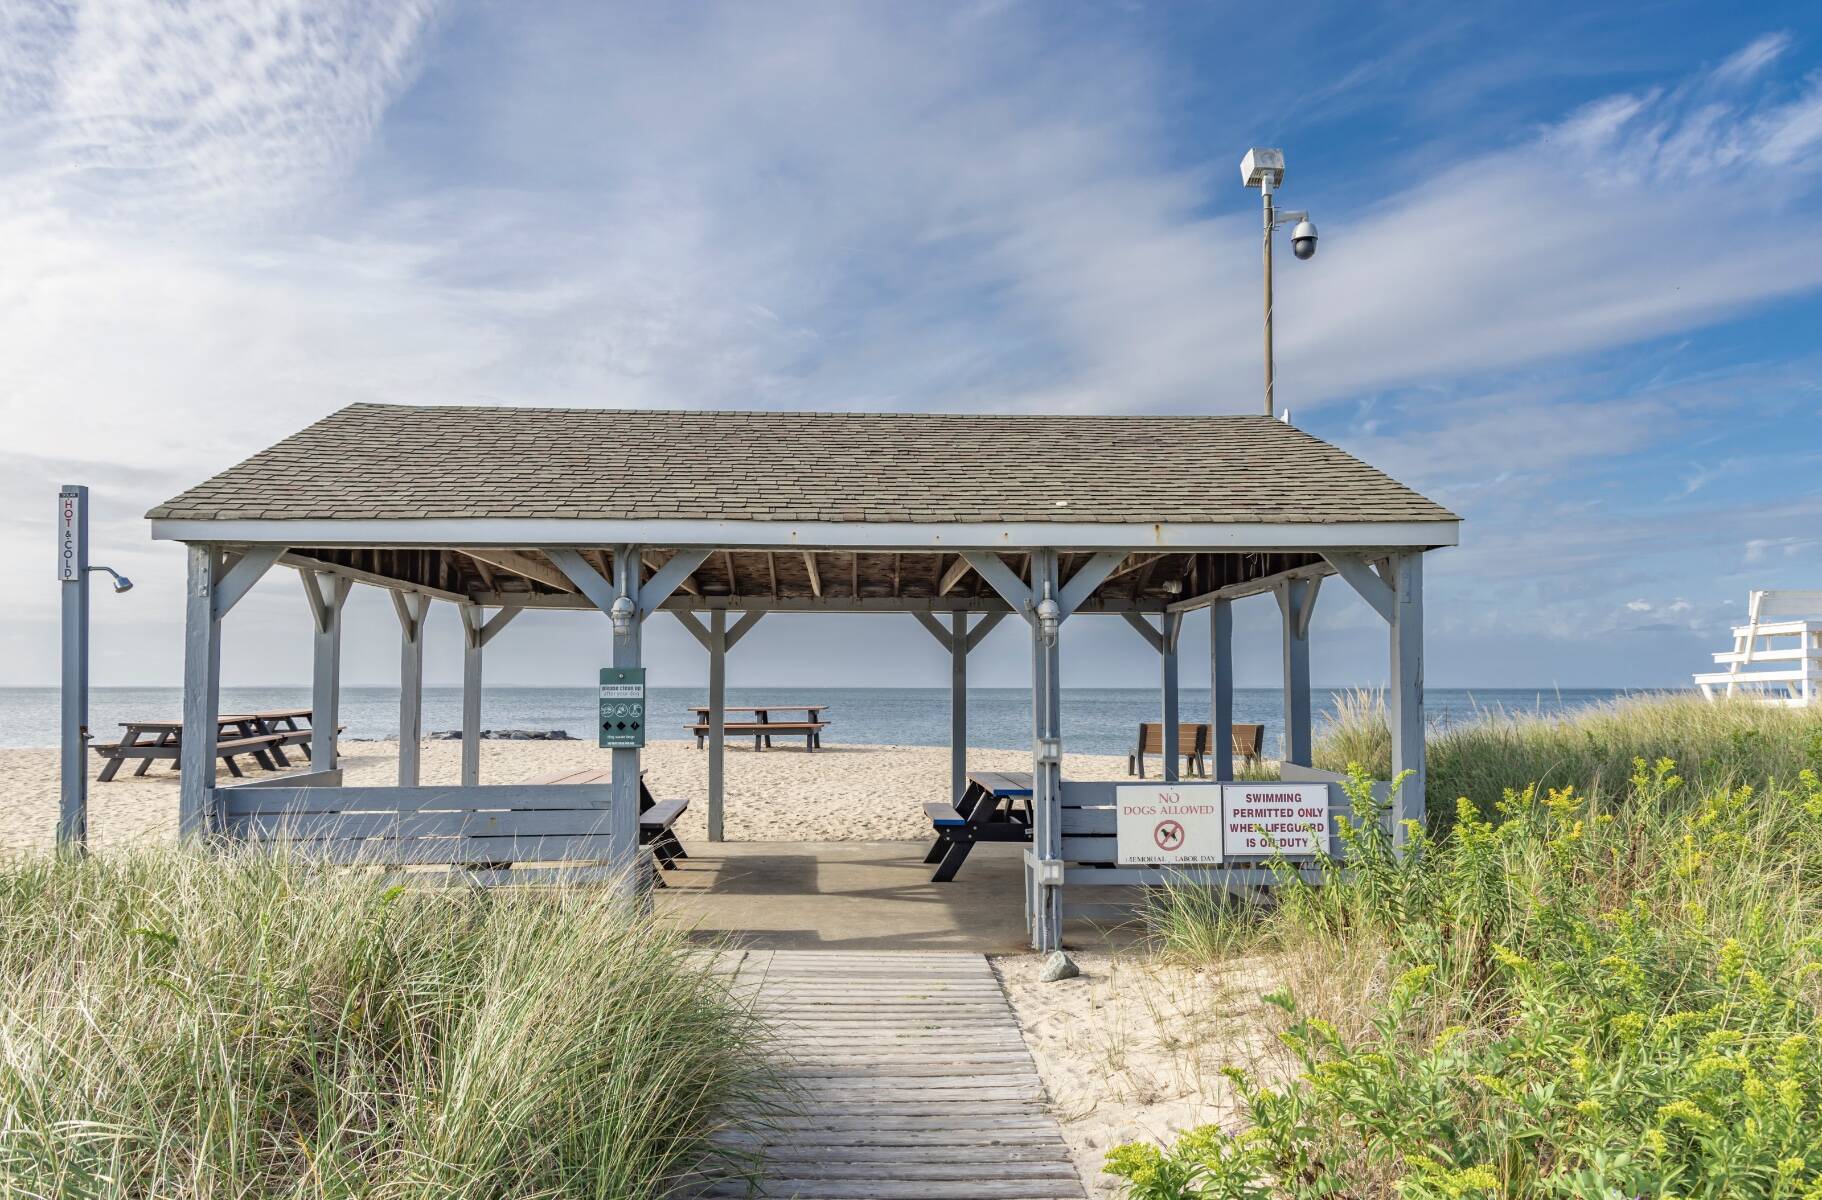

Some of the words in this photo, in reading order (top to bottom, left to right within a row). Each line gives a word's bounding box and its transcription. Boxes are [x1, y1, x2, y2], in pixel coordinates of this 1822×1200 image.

[64, 500, 73, 528] HOT
[64, 540, 73, 578] COLD
[1159, 792, 1180, 803] NO
[1245, 793, 1302, 803] SWIMMING
[1123, 806, 1157, 815] DOGS
[1160, 805, 1214, 815] ALLOWED
[1233, 808, 1293, 818] PERMITTED
[1297, 808, 1324, 817] ONLY
[1246, 838, 1256, 848] IS
[1280, 838, 1308, 847] DUTY
